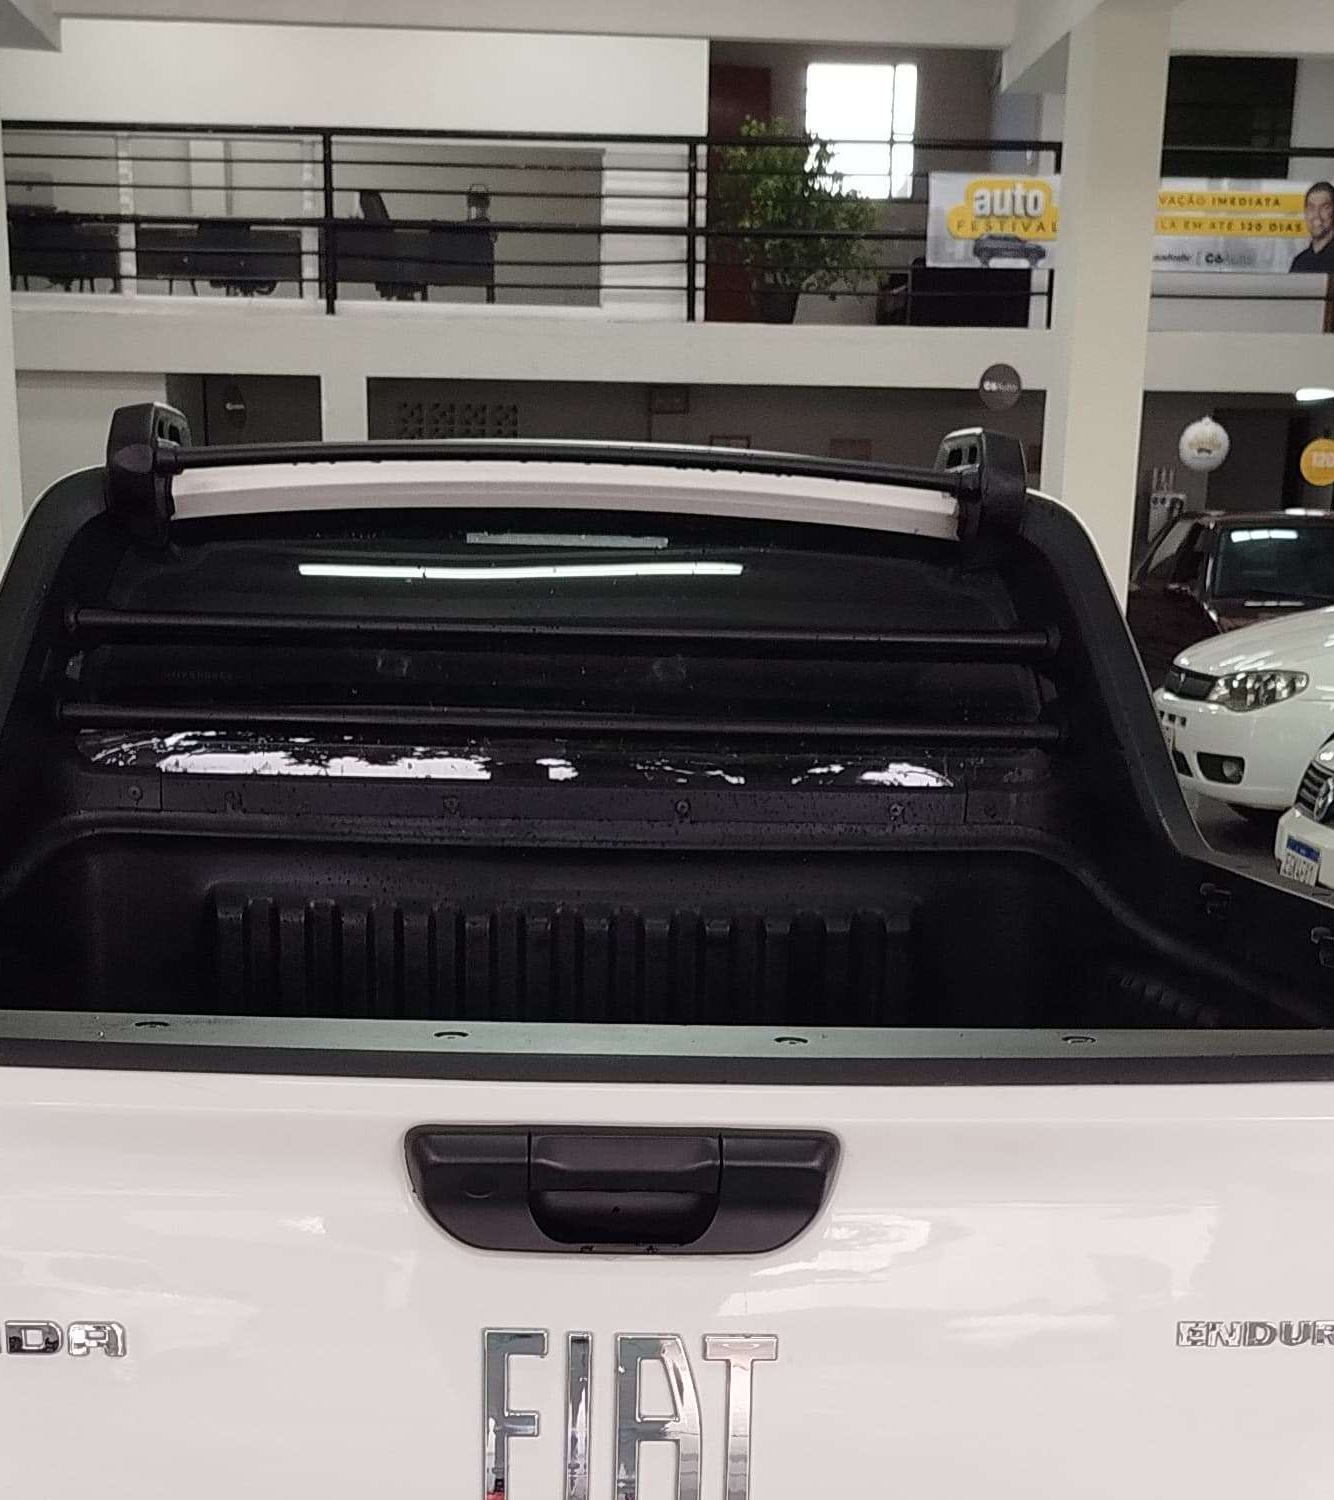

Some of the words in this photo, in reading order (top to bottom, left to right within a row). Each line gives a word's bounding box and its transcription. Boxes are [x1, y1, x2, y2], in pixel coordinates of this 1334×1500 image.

[974, 182, 1044, 217] auto
[1158, 194, 1205, 208] VAÇÃO
[1212, 195, 1281, 207] IMEDIATA
[1268, 221, 1302, 233] DIAS
